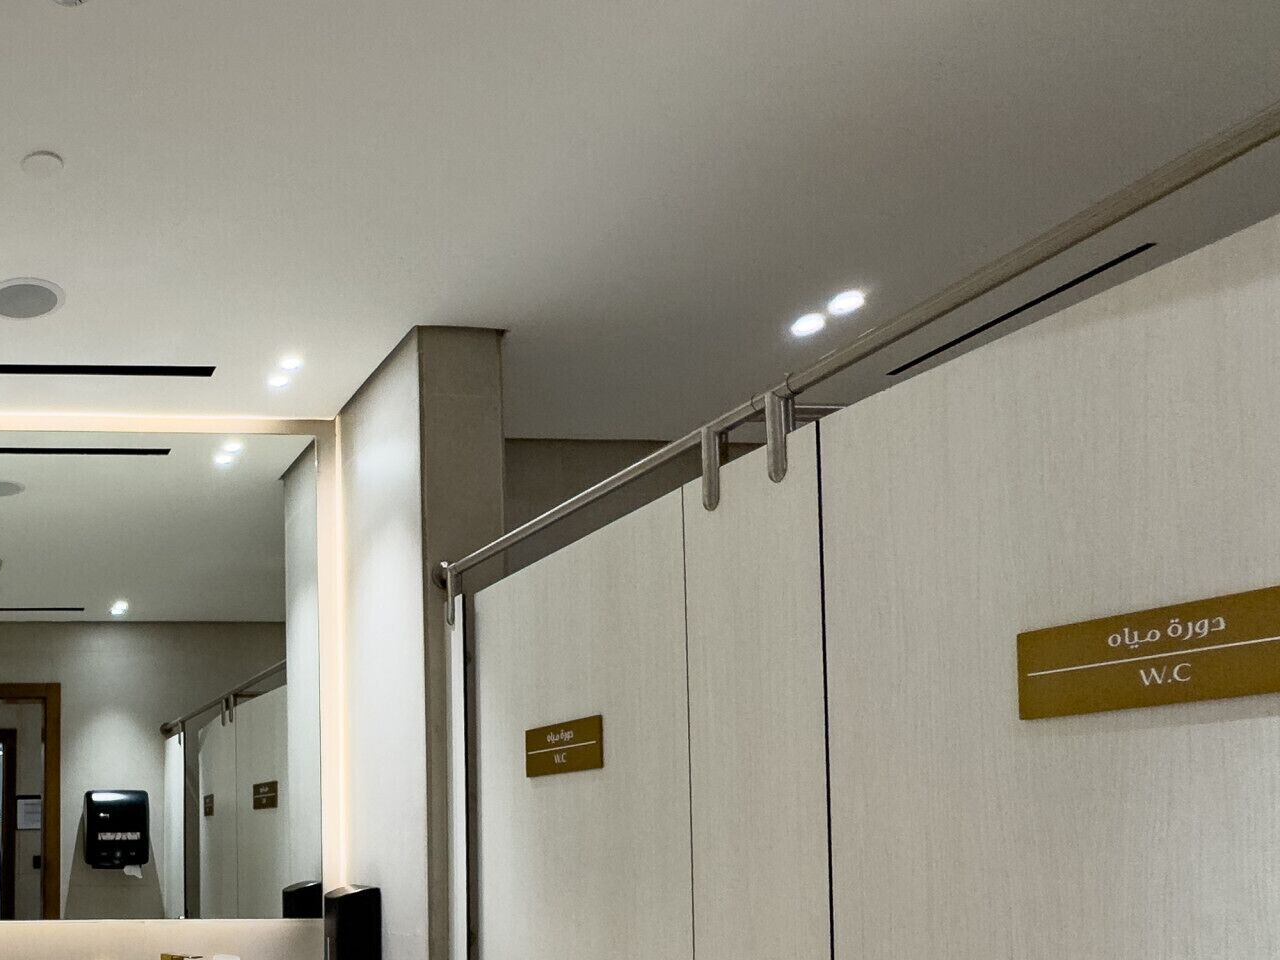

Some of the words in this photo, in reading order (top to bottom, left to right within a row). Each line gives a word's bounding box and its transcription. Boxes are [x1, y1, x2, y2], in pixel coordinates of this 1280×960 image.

[1108, 627, 1161, 649] مياه
[1167, 616, 1226, 640] دورة
[1139, 663, 1192, 686] W.C
